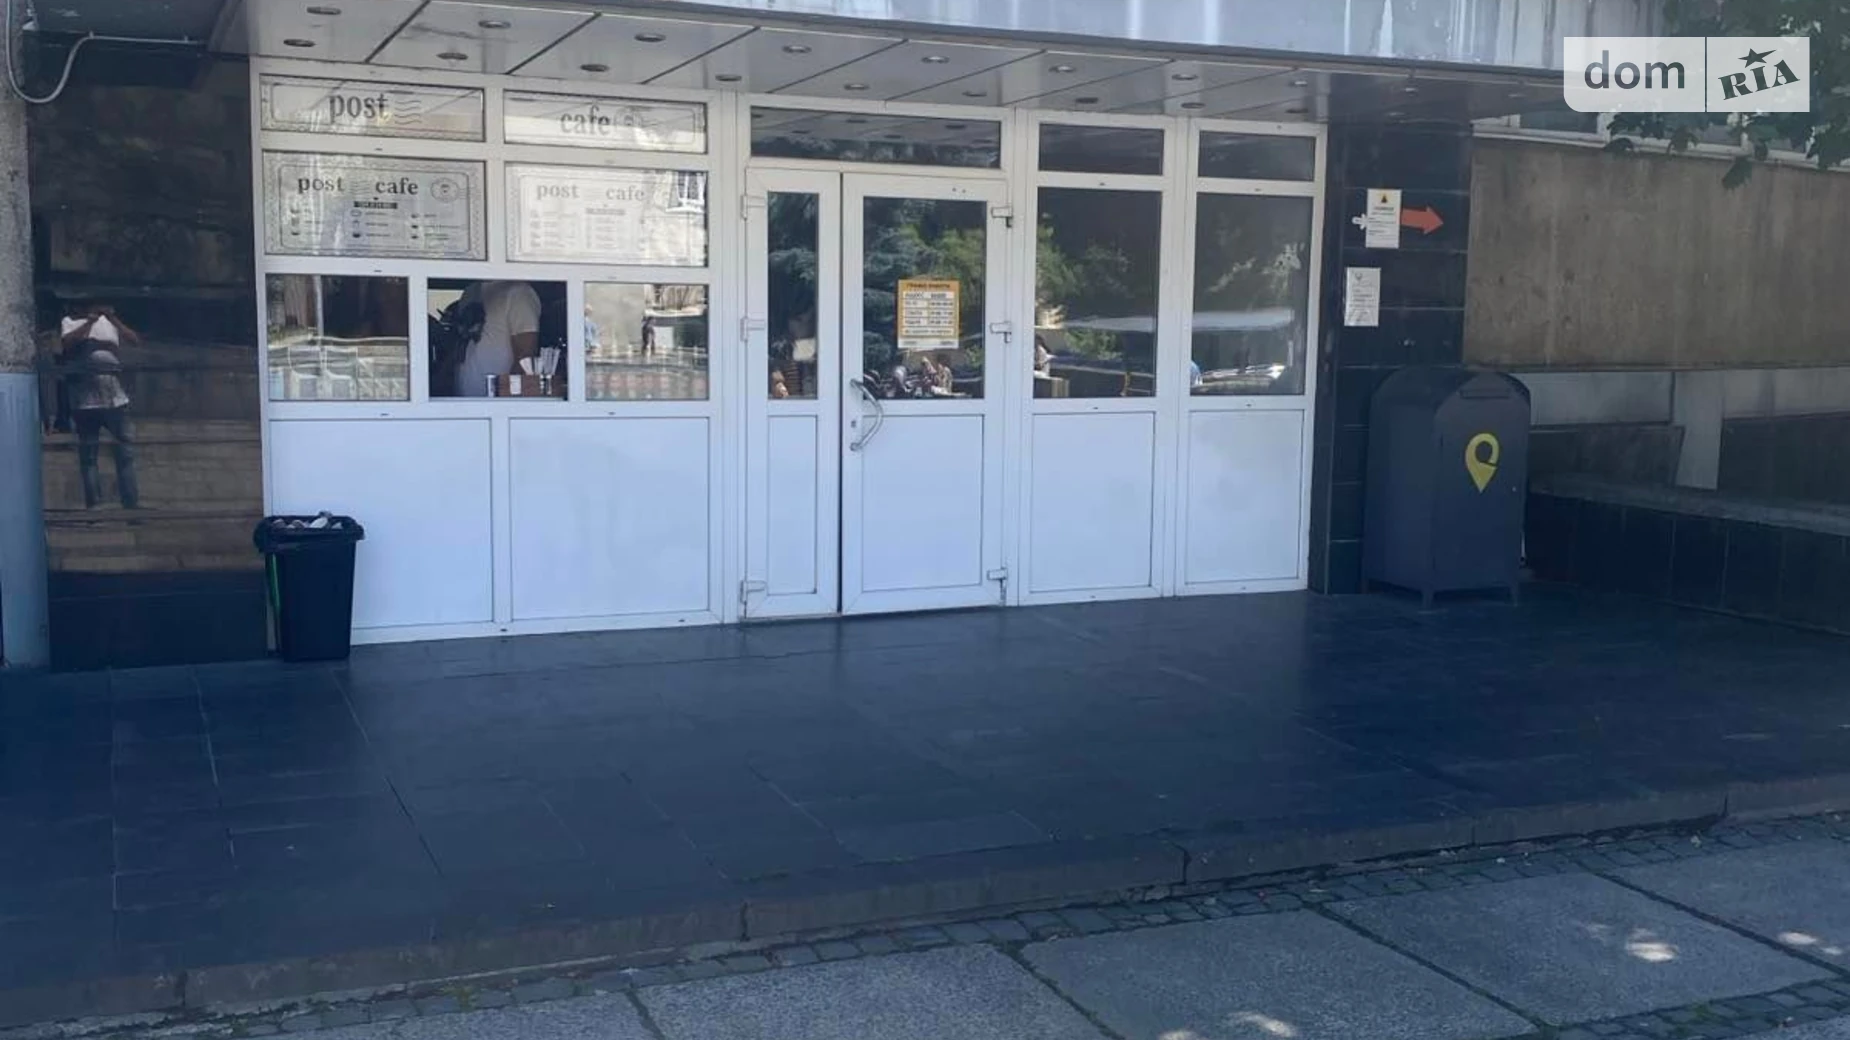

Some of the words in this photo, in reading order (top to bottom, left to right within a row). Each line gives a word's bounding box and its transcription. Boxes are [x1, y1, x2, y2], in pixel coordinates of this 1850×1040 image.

[329, 93, 388, 125] post
[560, 104, 610, 135] cafe
[298, 177, 345, 194] post
[375, 177, 418, 195] cafe
[537, 183, 580, 200] post
[606, 185, 644, 201] cafe
